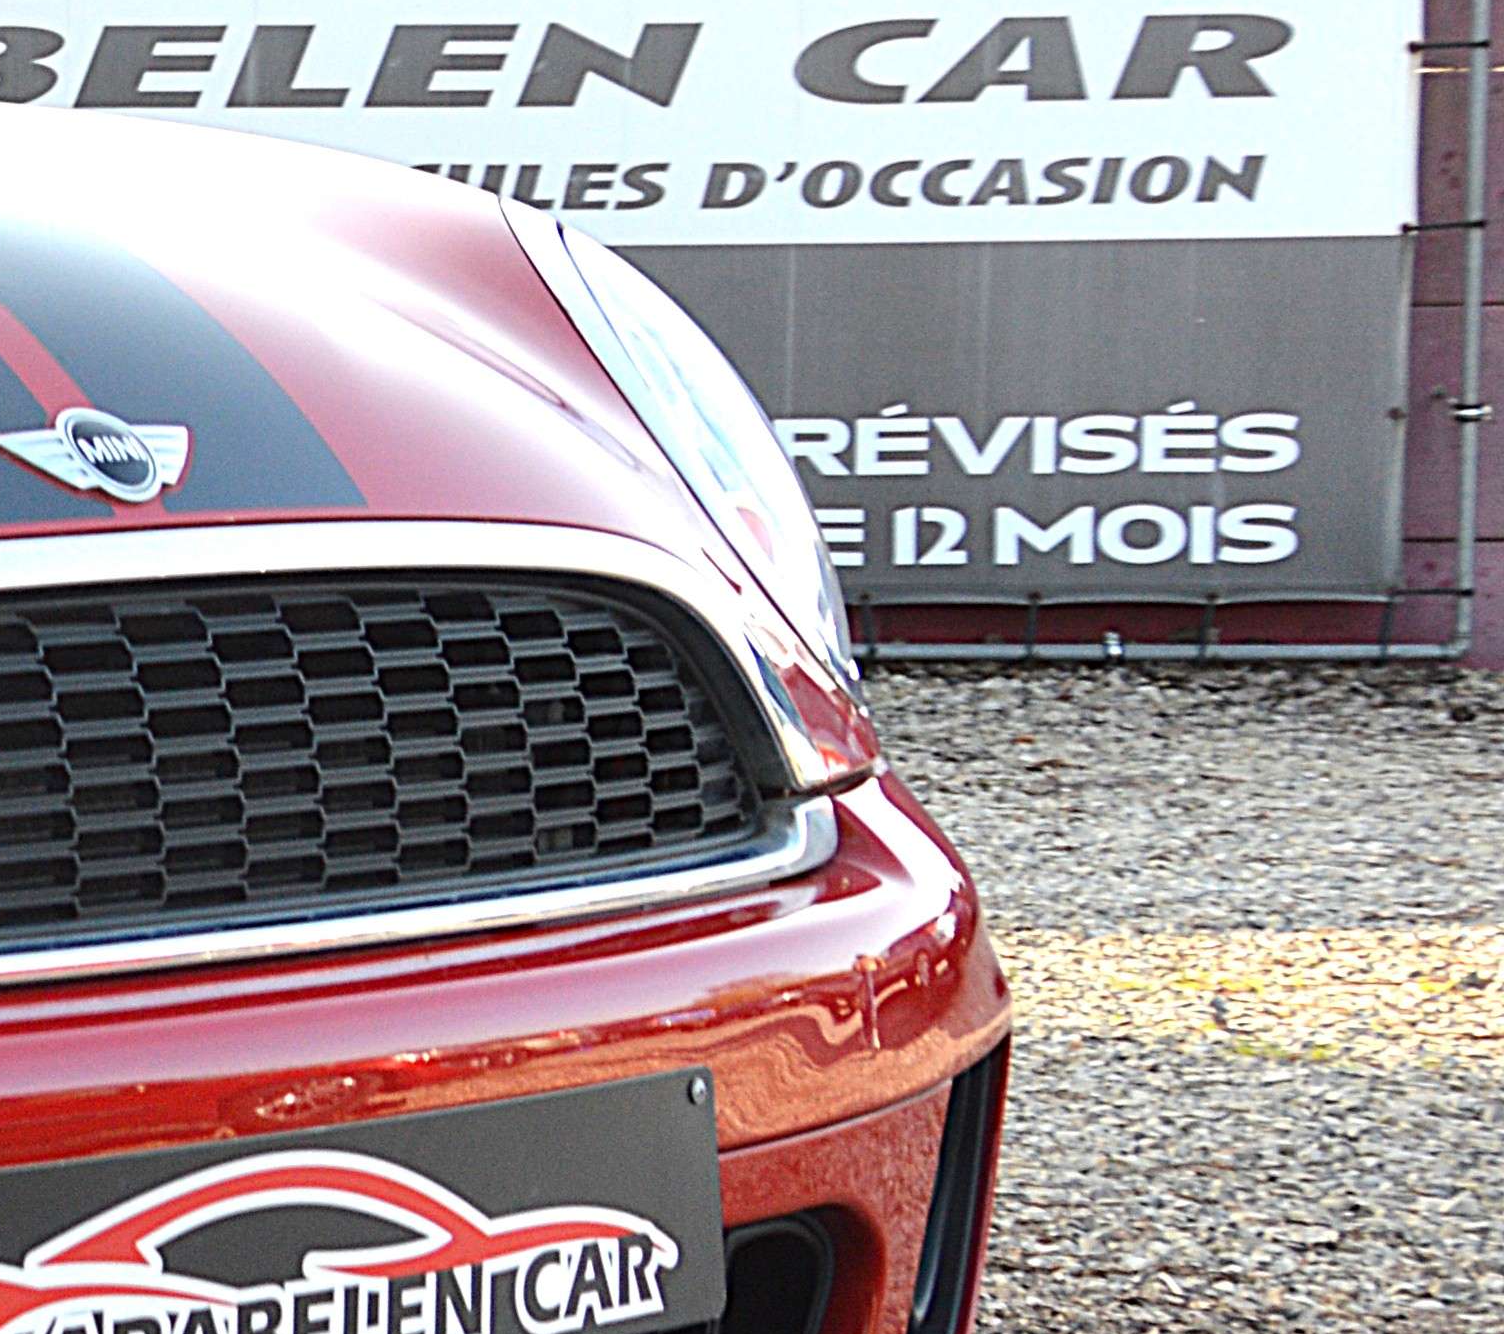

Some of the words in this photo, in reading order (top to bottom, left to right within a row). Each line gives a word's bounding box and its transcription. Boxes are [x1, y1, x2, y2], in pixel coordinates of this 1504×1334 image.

[793, 13, 1295, 105] CAR
[700, 154, 1265, 210] D'OCCASION
[77, 434, 147, 465] MINI
[772, 400, 1300, 476] RÉVISÉS
[893, 506, 969, 566] 12
[994, 503, 1299, 566] MOIS
[520, 1234, 664, 1325] CAR
